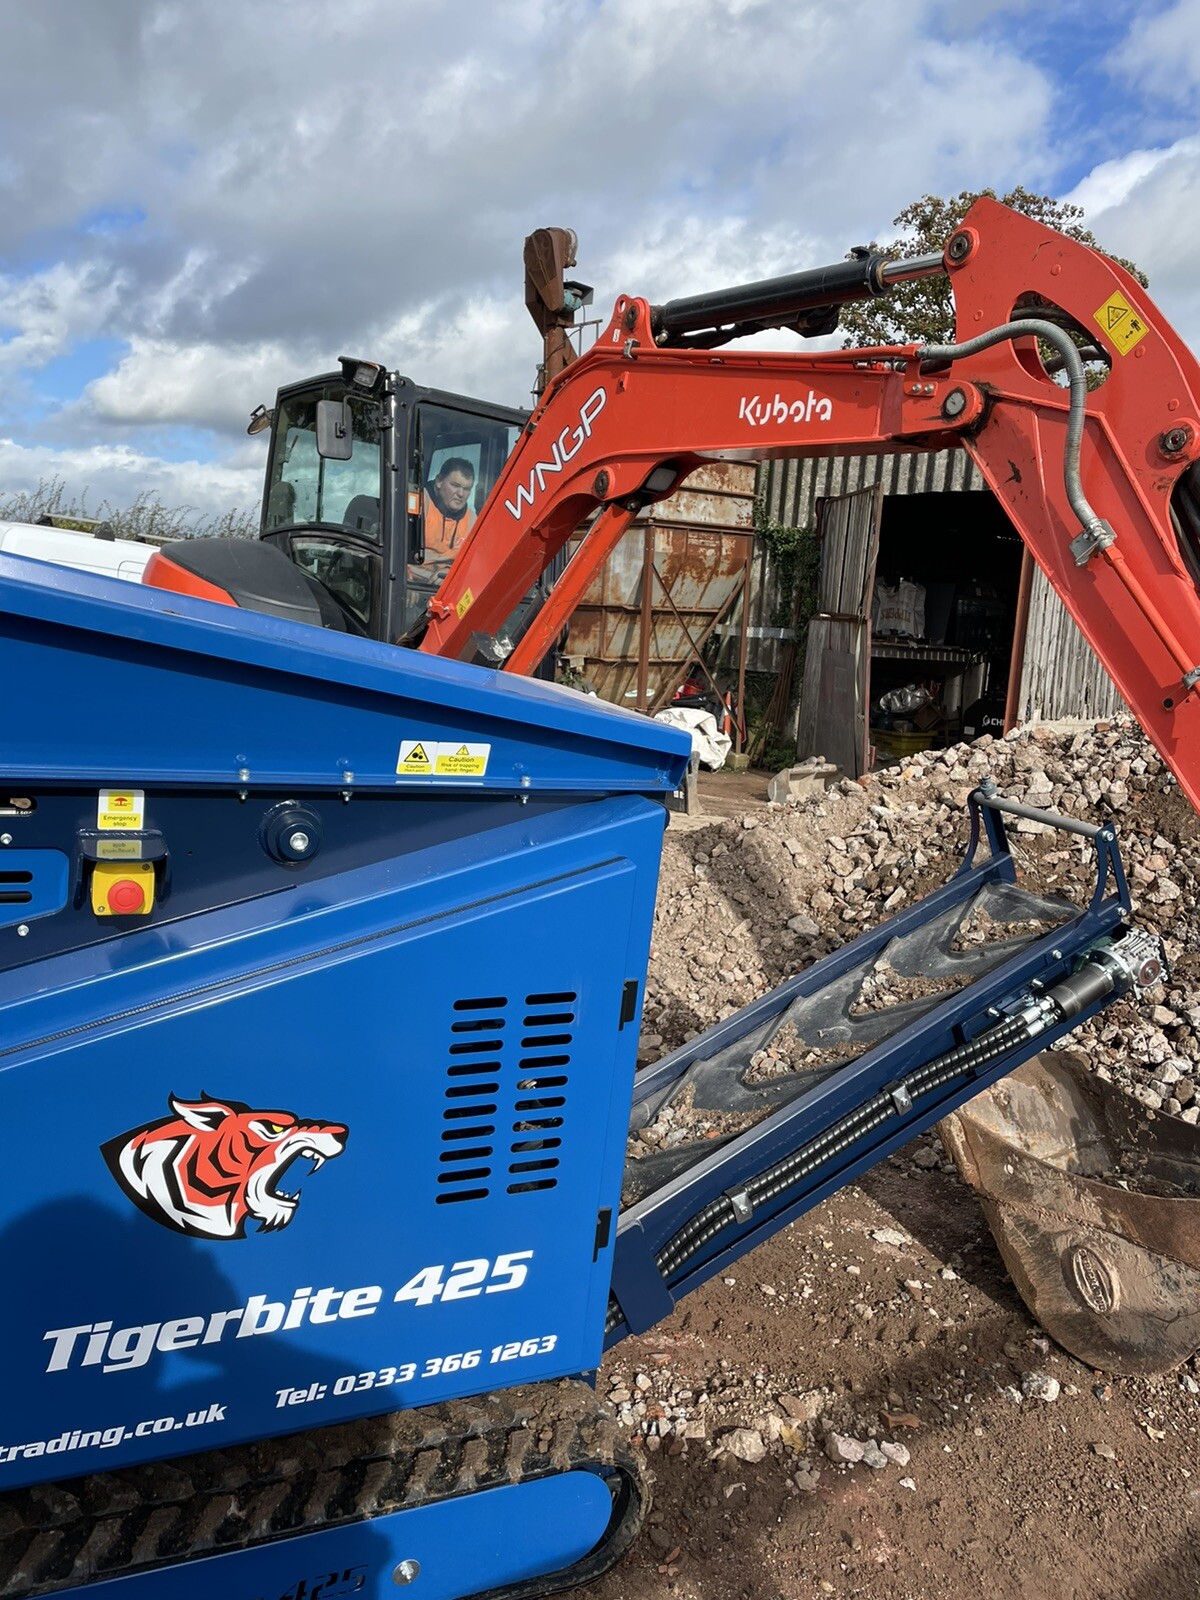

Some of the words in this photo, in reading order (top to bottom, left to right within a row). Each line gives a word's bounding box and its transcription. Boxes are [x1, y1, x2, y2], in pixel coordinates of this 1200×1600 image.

[739, 390, 833, 426] Kubota
[504, 386, 607, 520] WNGP
[103, 814, 138, 822] Emergency
[43, 1283, 384, 1374] Tigerbite
[392, 1249, 535, 1307] 425
[275, 1382, 328, 1409] Tel:
[332, 1362, 417, 1396] 0333
[421, 1349, 483, 1378] 366
[489, 1334, 558, 1364] 1263
